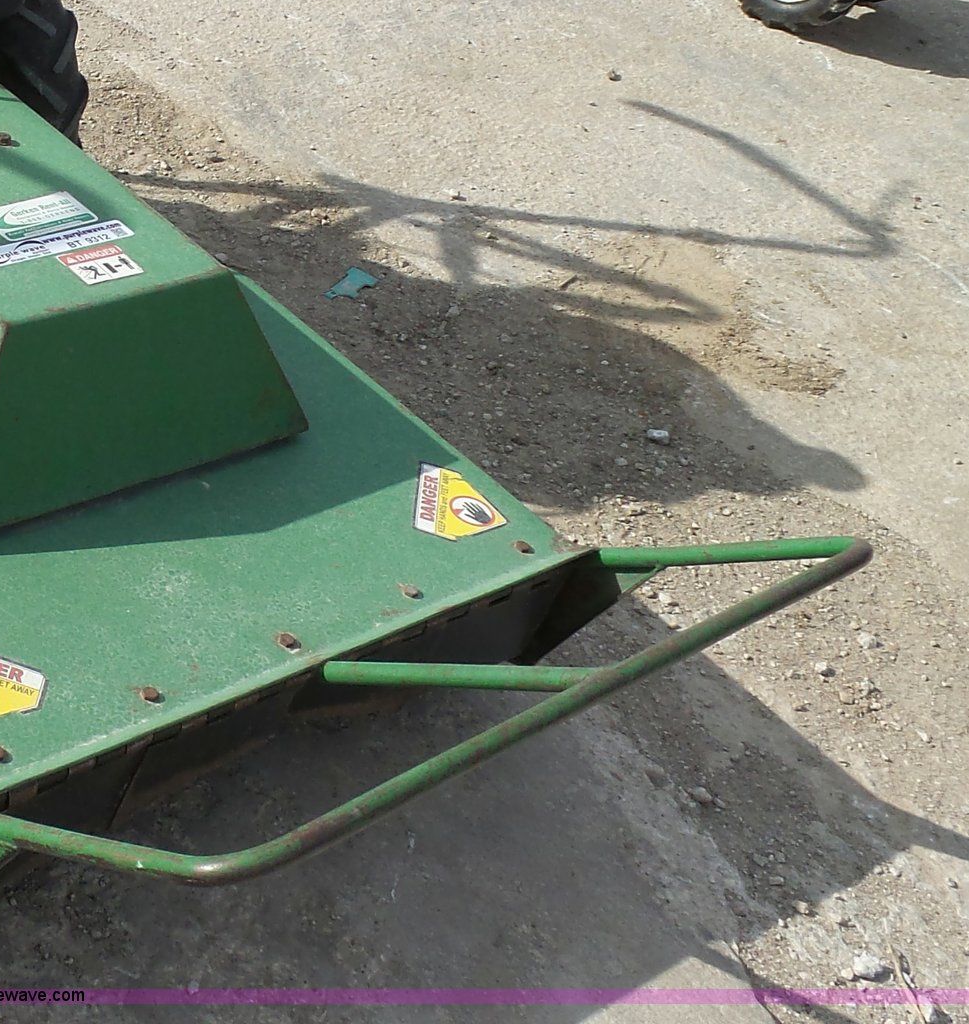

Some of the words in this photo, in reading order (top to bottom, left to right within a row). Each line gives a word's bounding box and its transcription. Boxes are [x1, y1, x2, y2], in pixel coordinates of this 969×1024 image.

[67, 240, 83, 249] BT
[85, 233, 112, 245] 9312
[21, 244, 46, 254] wave
[76, 247, 120, 262] DANGER
[420, 475, 439, 522] DANGER
[10, 683, 35, 697] AWAY
